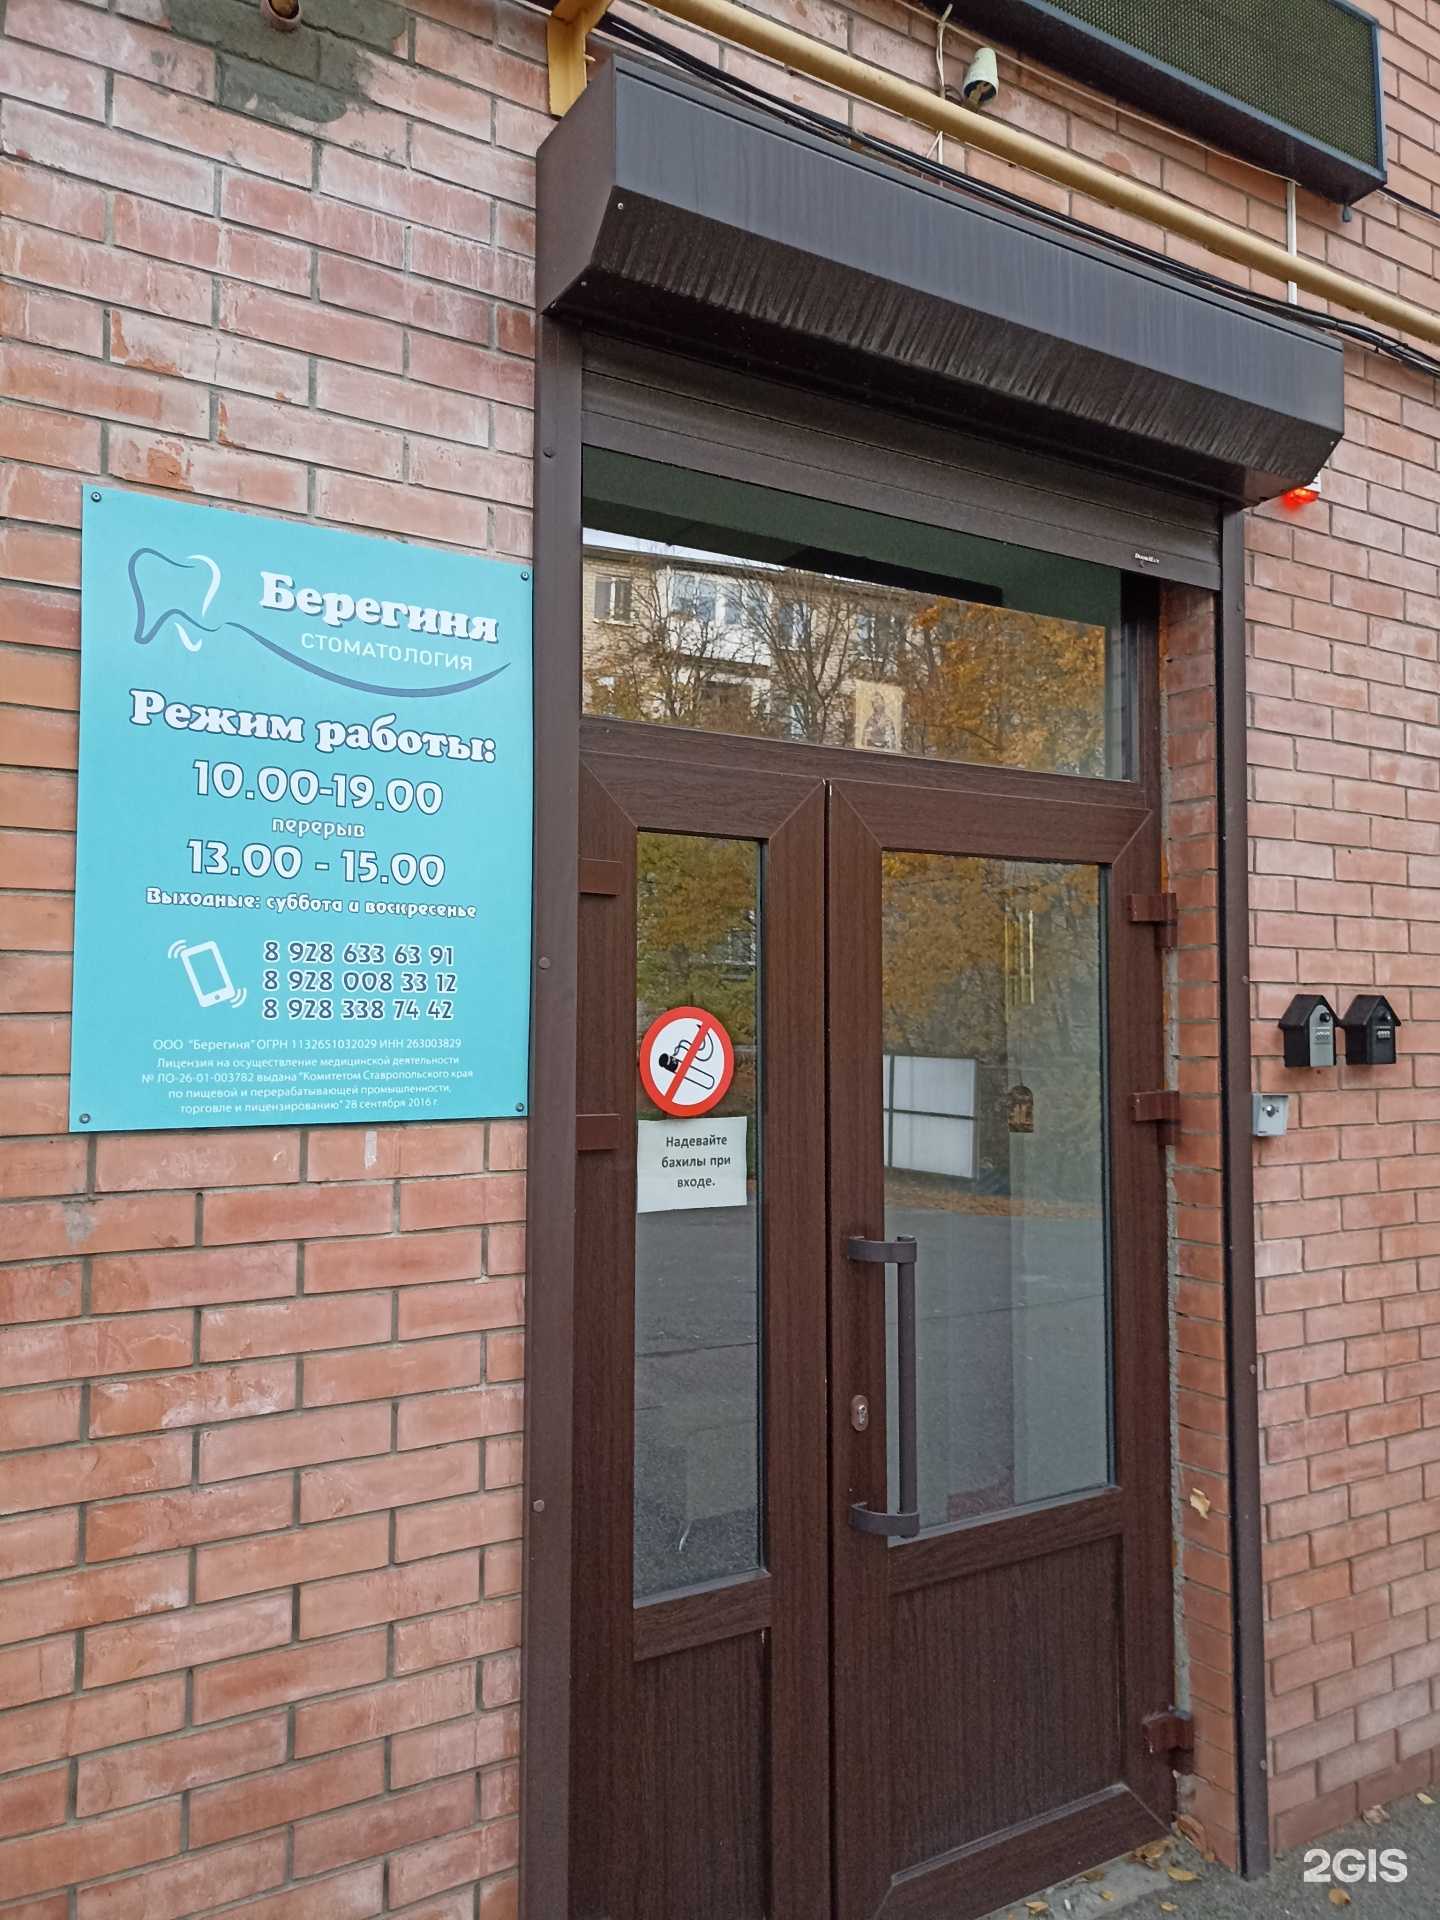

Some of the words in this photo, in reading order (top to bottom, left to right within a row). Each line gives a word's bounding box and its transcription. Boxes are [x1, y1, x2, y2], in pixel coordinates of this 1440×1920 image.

[259, 571, 500, 643] Берегиня
[300, 632, 474, 673] СТОМАТОЛОГИЯ
[129, 688, 305, 744] Режим
[314, 712, 497, 763] работы:
[192, 759, 444, 816] 10.00-19.00
[270, 816, 366, 840] перерыв
[187, 839, 302, 880] 13.00
[340, 849, 446, 887] 15.00
[145, 887, 261, 910] Выходные:
[266, 893, 343, 913] суббота
[348, 901, 360, 914] и
[365, 901, 478, 919] воскресенье
[263, 940, 280, 963] 8
[288, 941, 334, 963] 928
[342, 943, 386, 966] 633
[393, 945, 421, 966] 63
[429, 946, 454, 967] 91
[263, 969, 279, 991] 8
[288, 970, 333, 992] 928
[342, 971, 393, 993] 008
[401, 972, 428, 993] 33
[436, 973, 457, 993] 12
[262, 998, 279, 1020] 8
[287, 999, 333, 1020] 928
[341, 999, 385, 1020] 338
[393, 999, 420, 1020] 74
[426, 999, 454, 1020] 42
[153, 1039, 184, 1050] ООО
[256, 1039, 288, 1050] ОГРН
[379, 1039, 404, 1049] ИНН
[156, 1057, 214, 1069] Лицензия
[216, 1060, 230, 1068] на
[232, 1058, 316, 1069] осуществление
[319, 1056, 391, 1067] медицинской
[392, 1056, 460, 1066] деятельности
[141, 1073, 154, 1083] №
[256, 1073, 297, 1083] выдана
[362, 1070, 449, 1081] Ставропольского
[451, 1070, 474, 1080] края
[168, 1090, 184, 1099] по
[186, 1088, 238, 1099] пищевой
[240, 1089, 249, 1097] и
[250, 1086, 359, 1098] перерабатывающей
[181, 1104, 233, 1115] торговле
[235, 1104, 243, 1113] и
[344, 1099, 358, 1109] 28
[359, 1098, 406, 1110] сентября
[408, 1097, 432, 1107] 2016
[666, 1133, 728, 1149] Надевайте
[661, 1157, 706, 1169] бахилы
[710, 1156, 731, 1168] при
[677, 1176, 716, 1191] входе.
